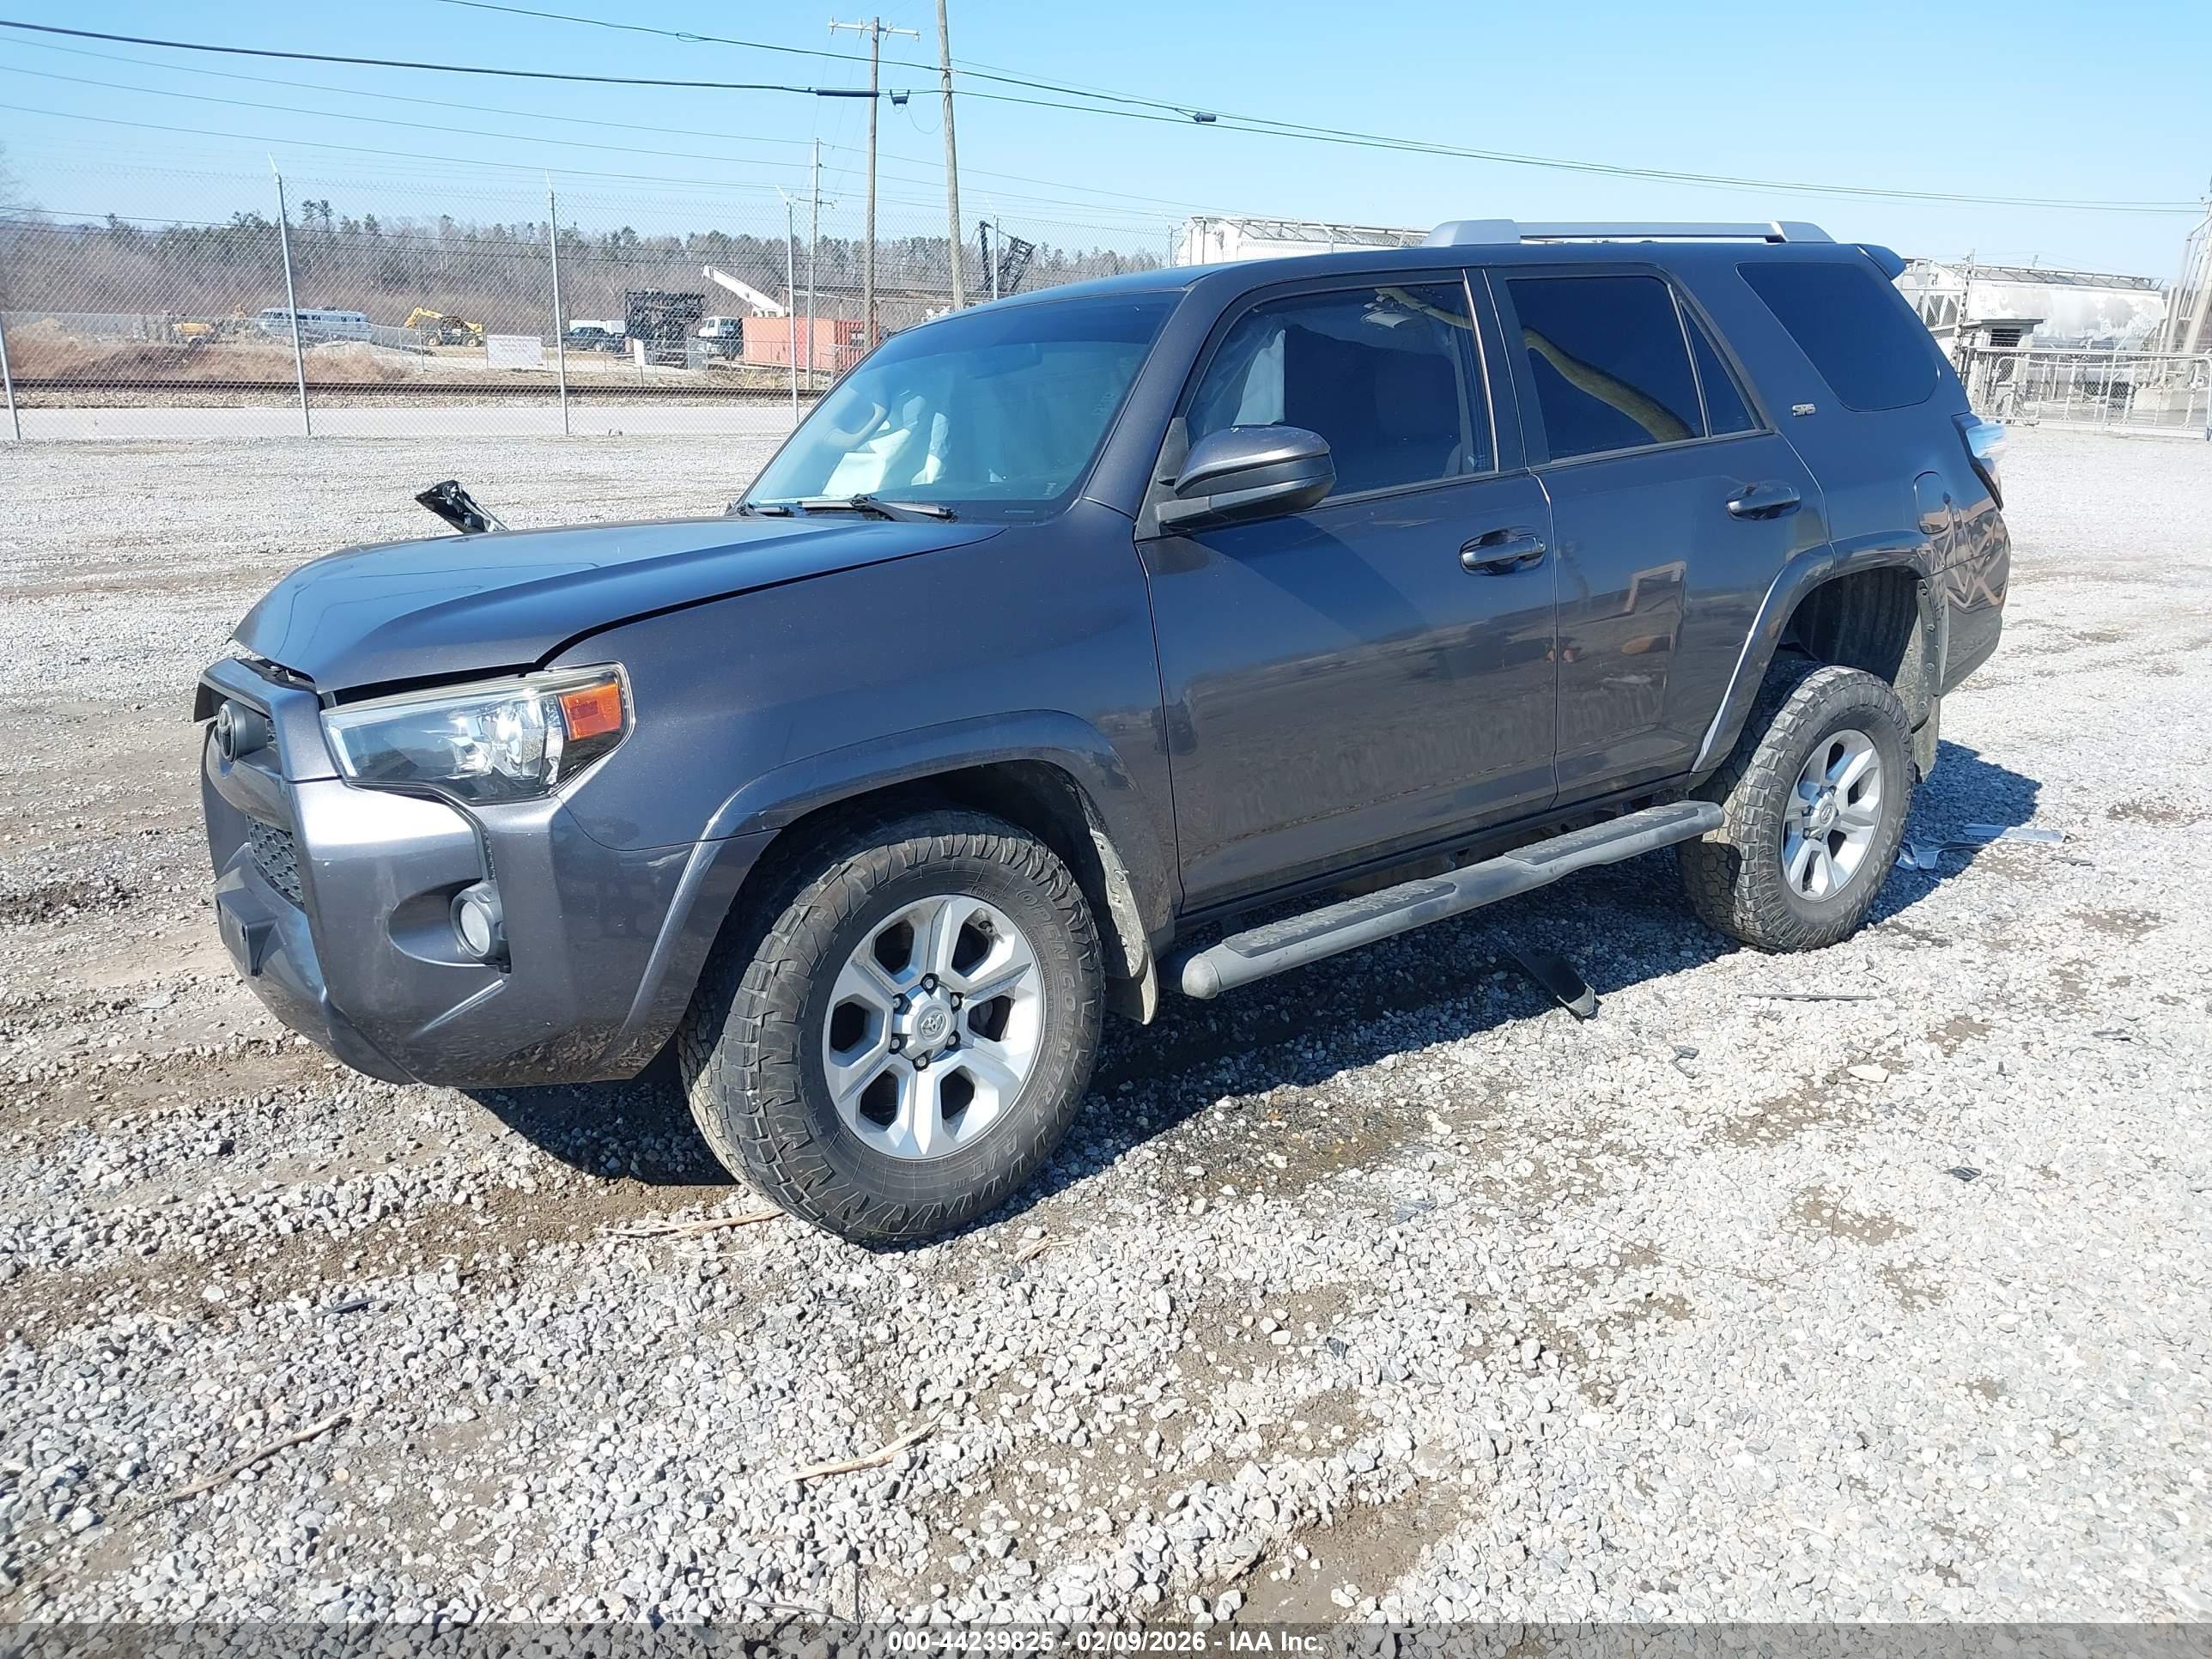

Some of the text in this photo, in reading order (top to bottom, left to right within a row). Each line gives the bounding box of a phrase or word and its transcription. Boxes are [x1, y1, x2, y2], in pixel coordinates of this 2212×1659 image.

[1872, 817, 1899, 877] TOYO
[1016, 889, 1071, 961] OPEN
[1031, 968, 1077, 1127] COUNTRY
